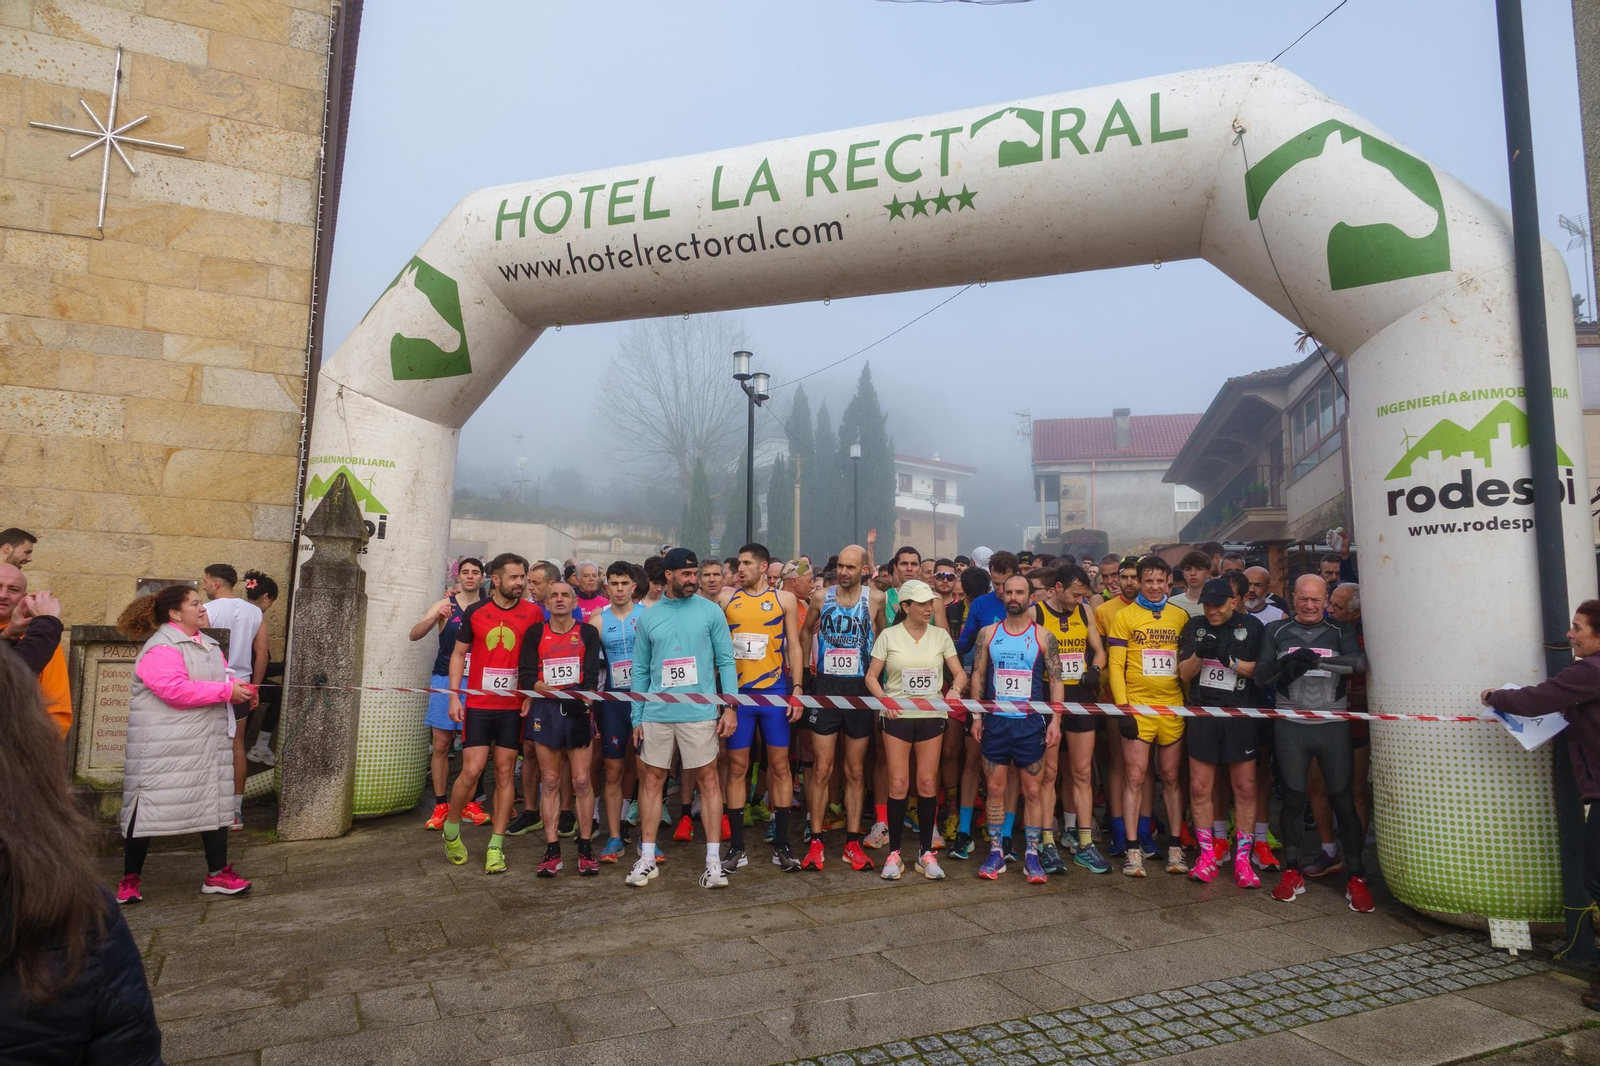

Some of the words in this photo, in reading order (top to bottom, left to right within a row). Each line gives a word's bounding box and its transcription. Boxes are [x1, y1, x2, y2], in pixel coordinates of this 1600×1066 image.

[495, 176, 670, 241] HOTEL
[711, 158, 781, 211] LA
[498, 216, 844, 283] www.hotelrectoral.com
[1387, 468, 1576, 516] rodesi
[822, 614, 868, 637] ADN
[747, 641, 752, 653] 1
[1057, 639, 1085, 647] NINOS
[103, 645, 138, 657] PAZO
[832, 656, 852, 668] 103
[1151, 657, 1172, 669] 114
[102, 670, 131, 678] DORADO
[551, 666, 573, 679] 153
[670, 667, 686, 680] 58
[1209, 668, 1225, 681] 68
[493, 677, 509, 688] 62
[909, 676, 931, 689] 655
[1005, 677, 1019, 690] 91
[101, 714, 129, 723] RECONS
[96, 728, 128, 738] COMUNID
[95, 742, 127, 752] INAUGUR
